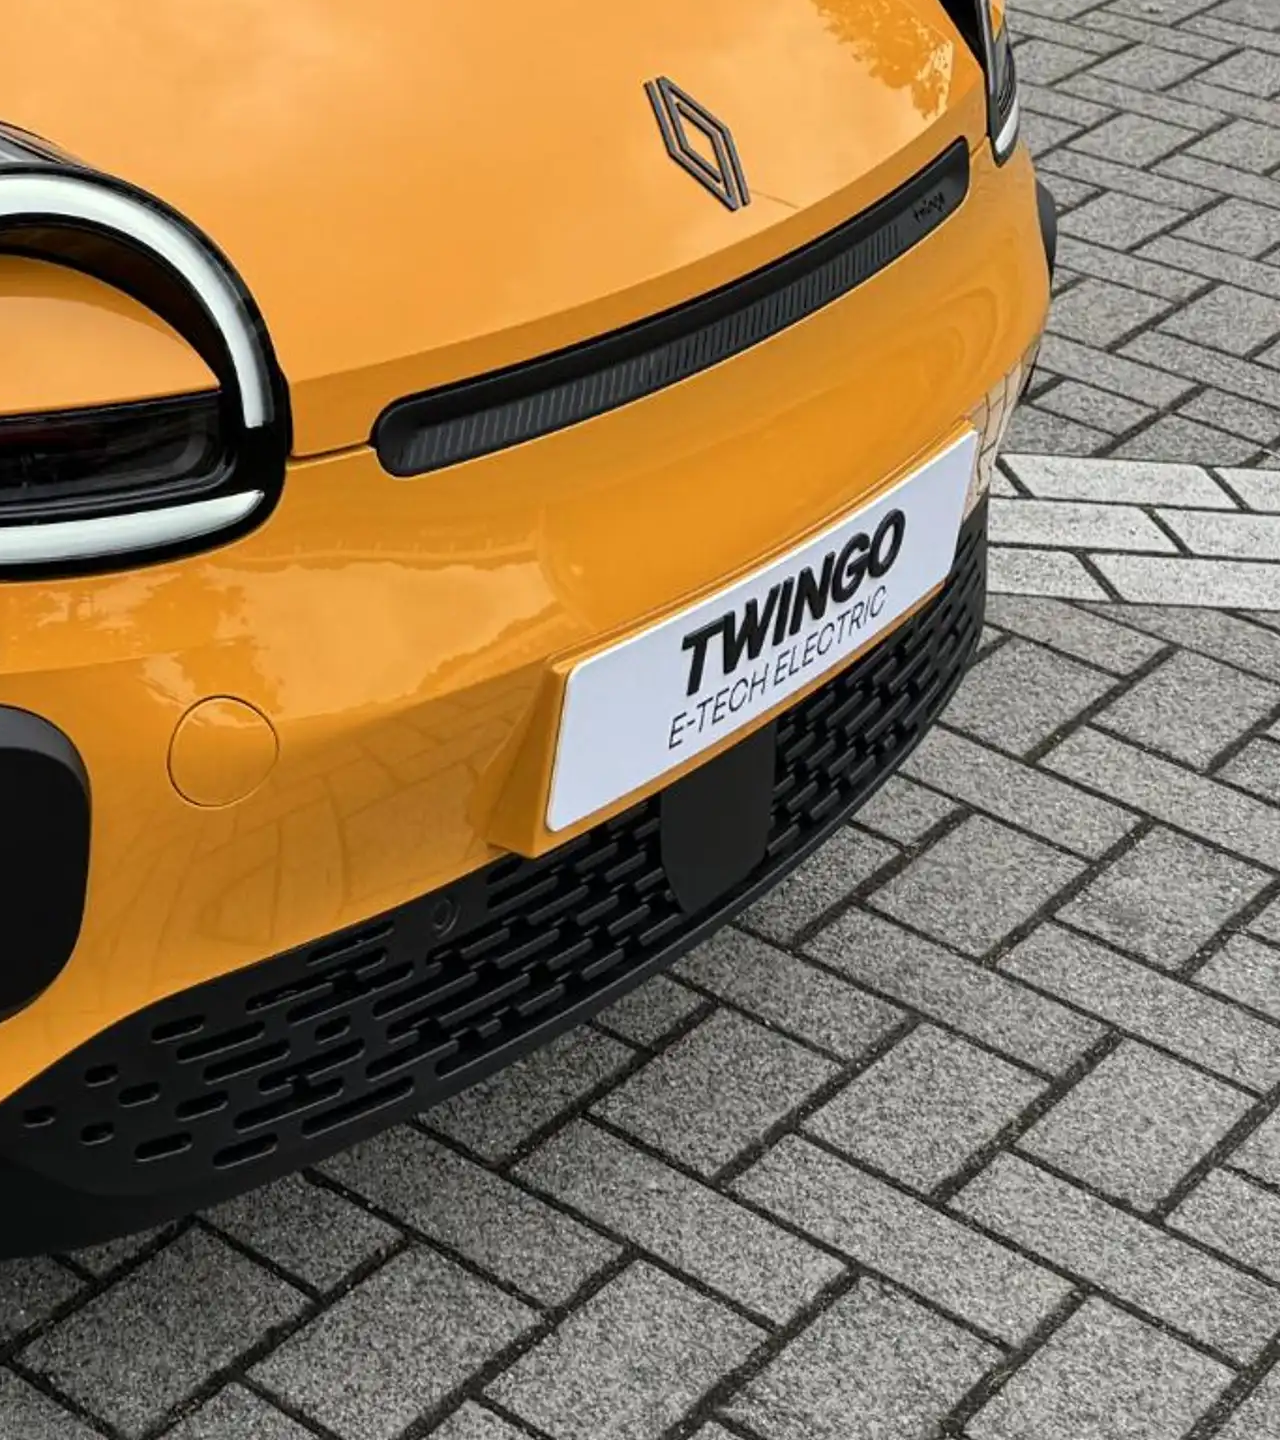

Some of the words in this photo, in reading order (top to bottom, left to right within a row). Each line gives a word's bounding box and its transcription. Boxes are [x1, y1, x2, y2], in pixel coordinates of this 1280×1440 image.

[668, 662, 770, 750] E-TECH
[773, 585, 887, 686] ELECTRIC
[681, 508, 907, 697] TWINGO
